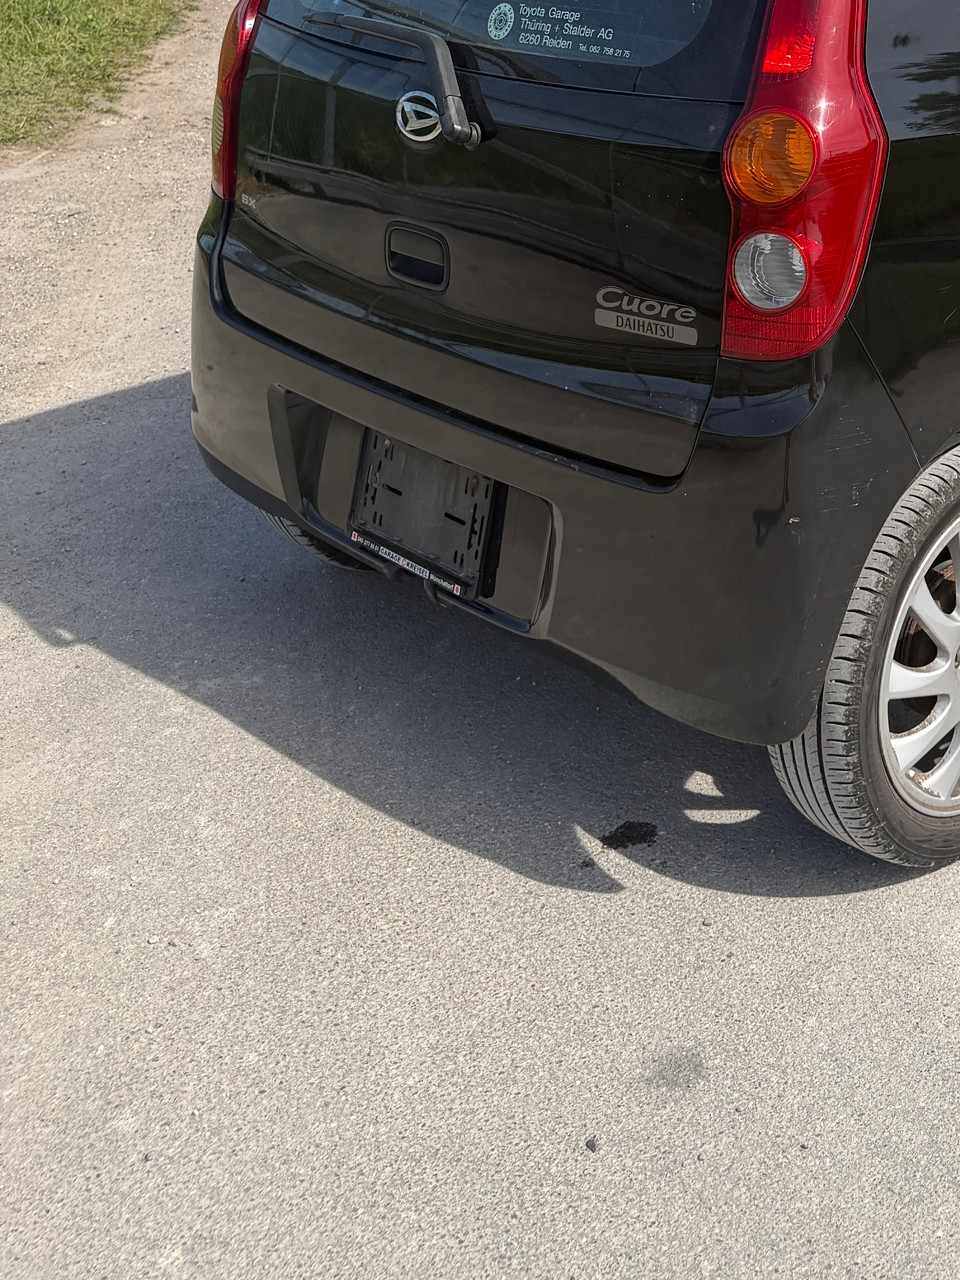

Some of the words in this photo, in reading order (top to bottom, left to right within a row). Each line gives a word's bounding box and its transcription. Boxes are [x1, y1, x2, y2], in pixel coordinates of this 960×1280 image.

[519, 3, 546, 18] Toyota
[548, 6, 581, 23] Garage
[520, 17, 552, 35] Thüring
[562, 22, 596, 38] Stalder
[596, 27, 614, 40] AG
[518, 32, 541, 46] 6260
[541, 35, 573, 50] Reiden
[588, 45, 601, 54] 062
[596, 286, 698, 323] Cuore
[616, 315, 675, 339] DAIHATSU
[380, 547, 401, 563] GARAGE
[406, 560, 429, 578] KREISEL
